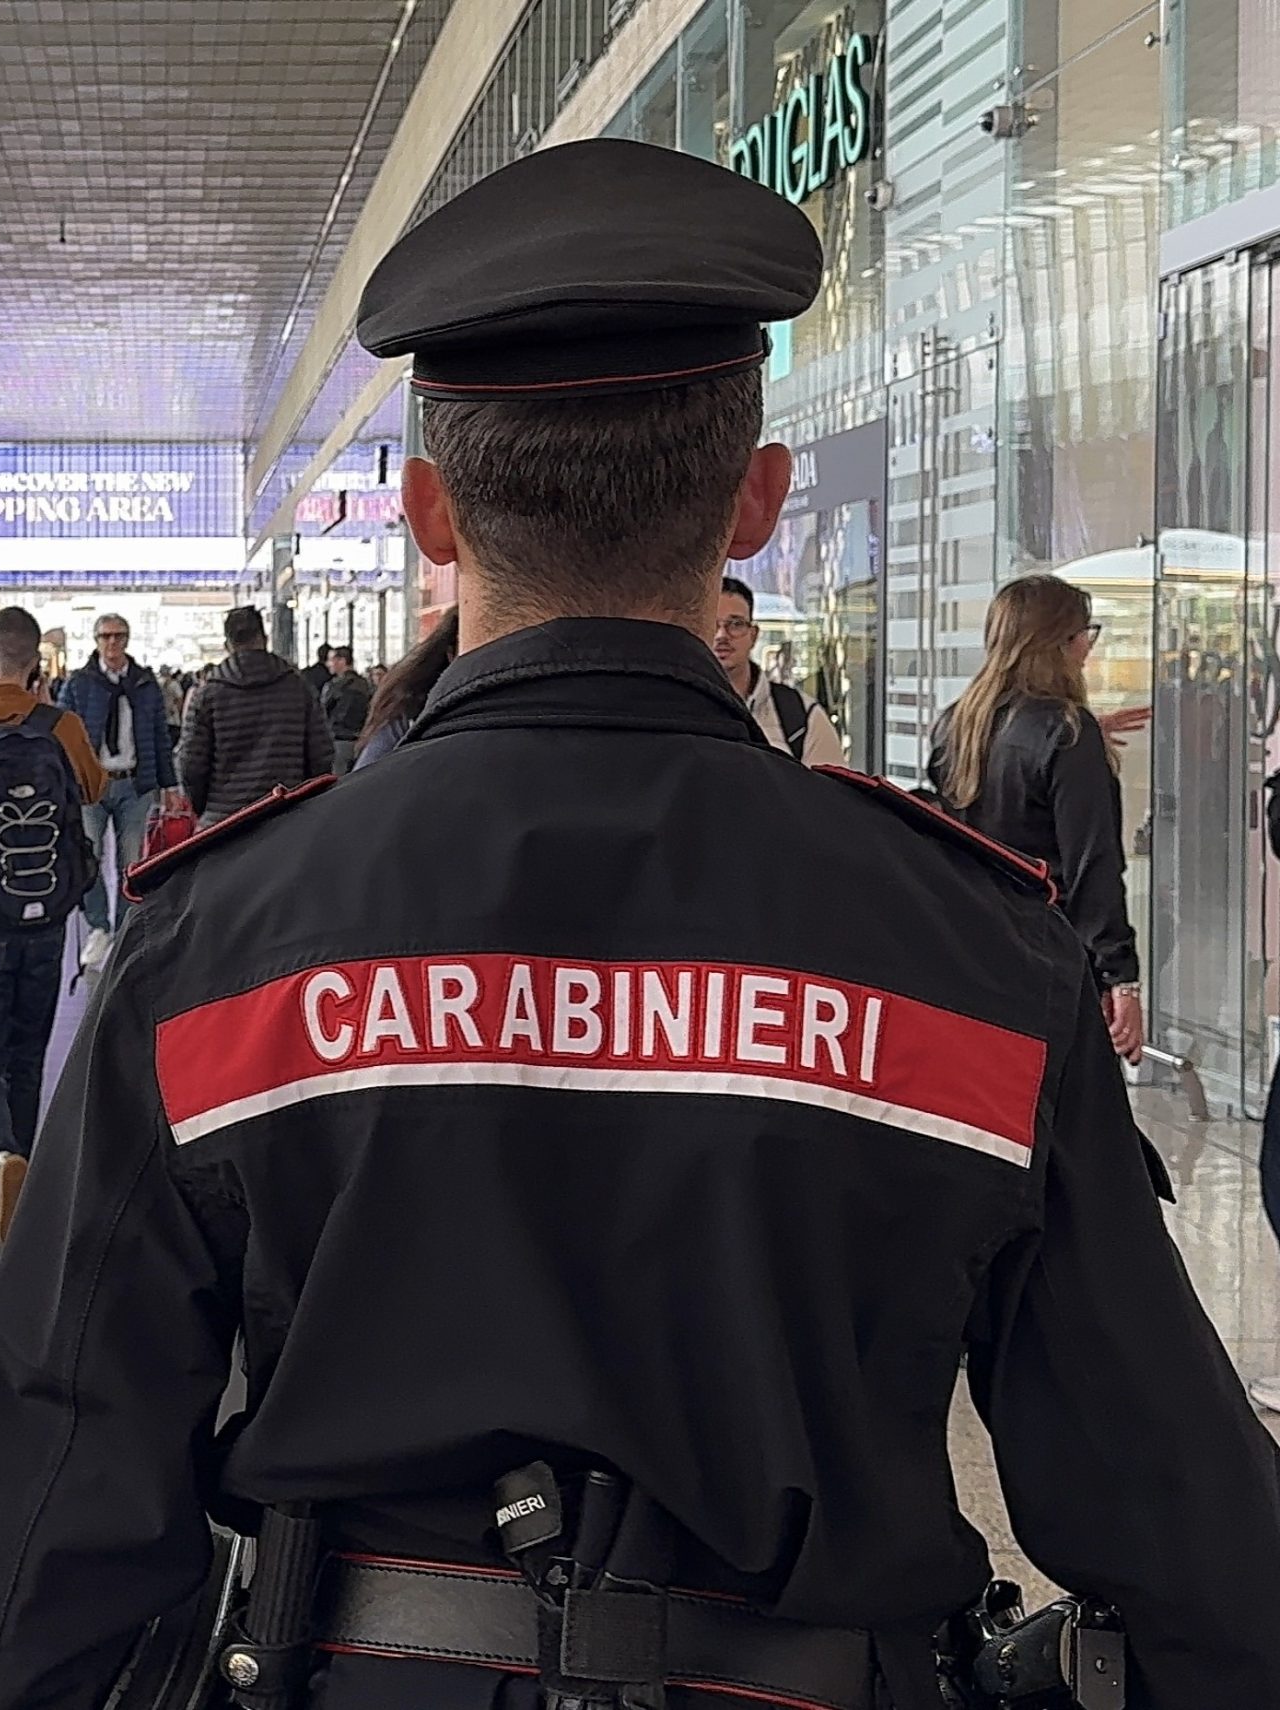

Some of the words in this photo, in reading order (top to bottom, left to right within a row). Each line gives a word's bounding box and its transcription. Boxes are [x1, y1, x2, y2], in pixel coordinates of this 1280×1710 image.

[729, 32, 867, 205] OUGLAS
[86, 495, 176, 523] AREA
[91, 471, 138, 493] THE
[140, 470, 196, 493] NEW
[303, 963, 883, 1084] CARABINIERI
